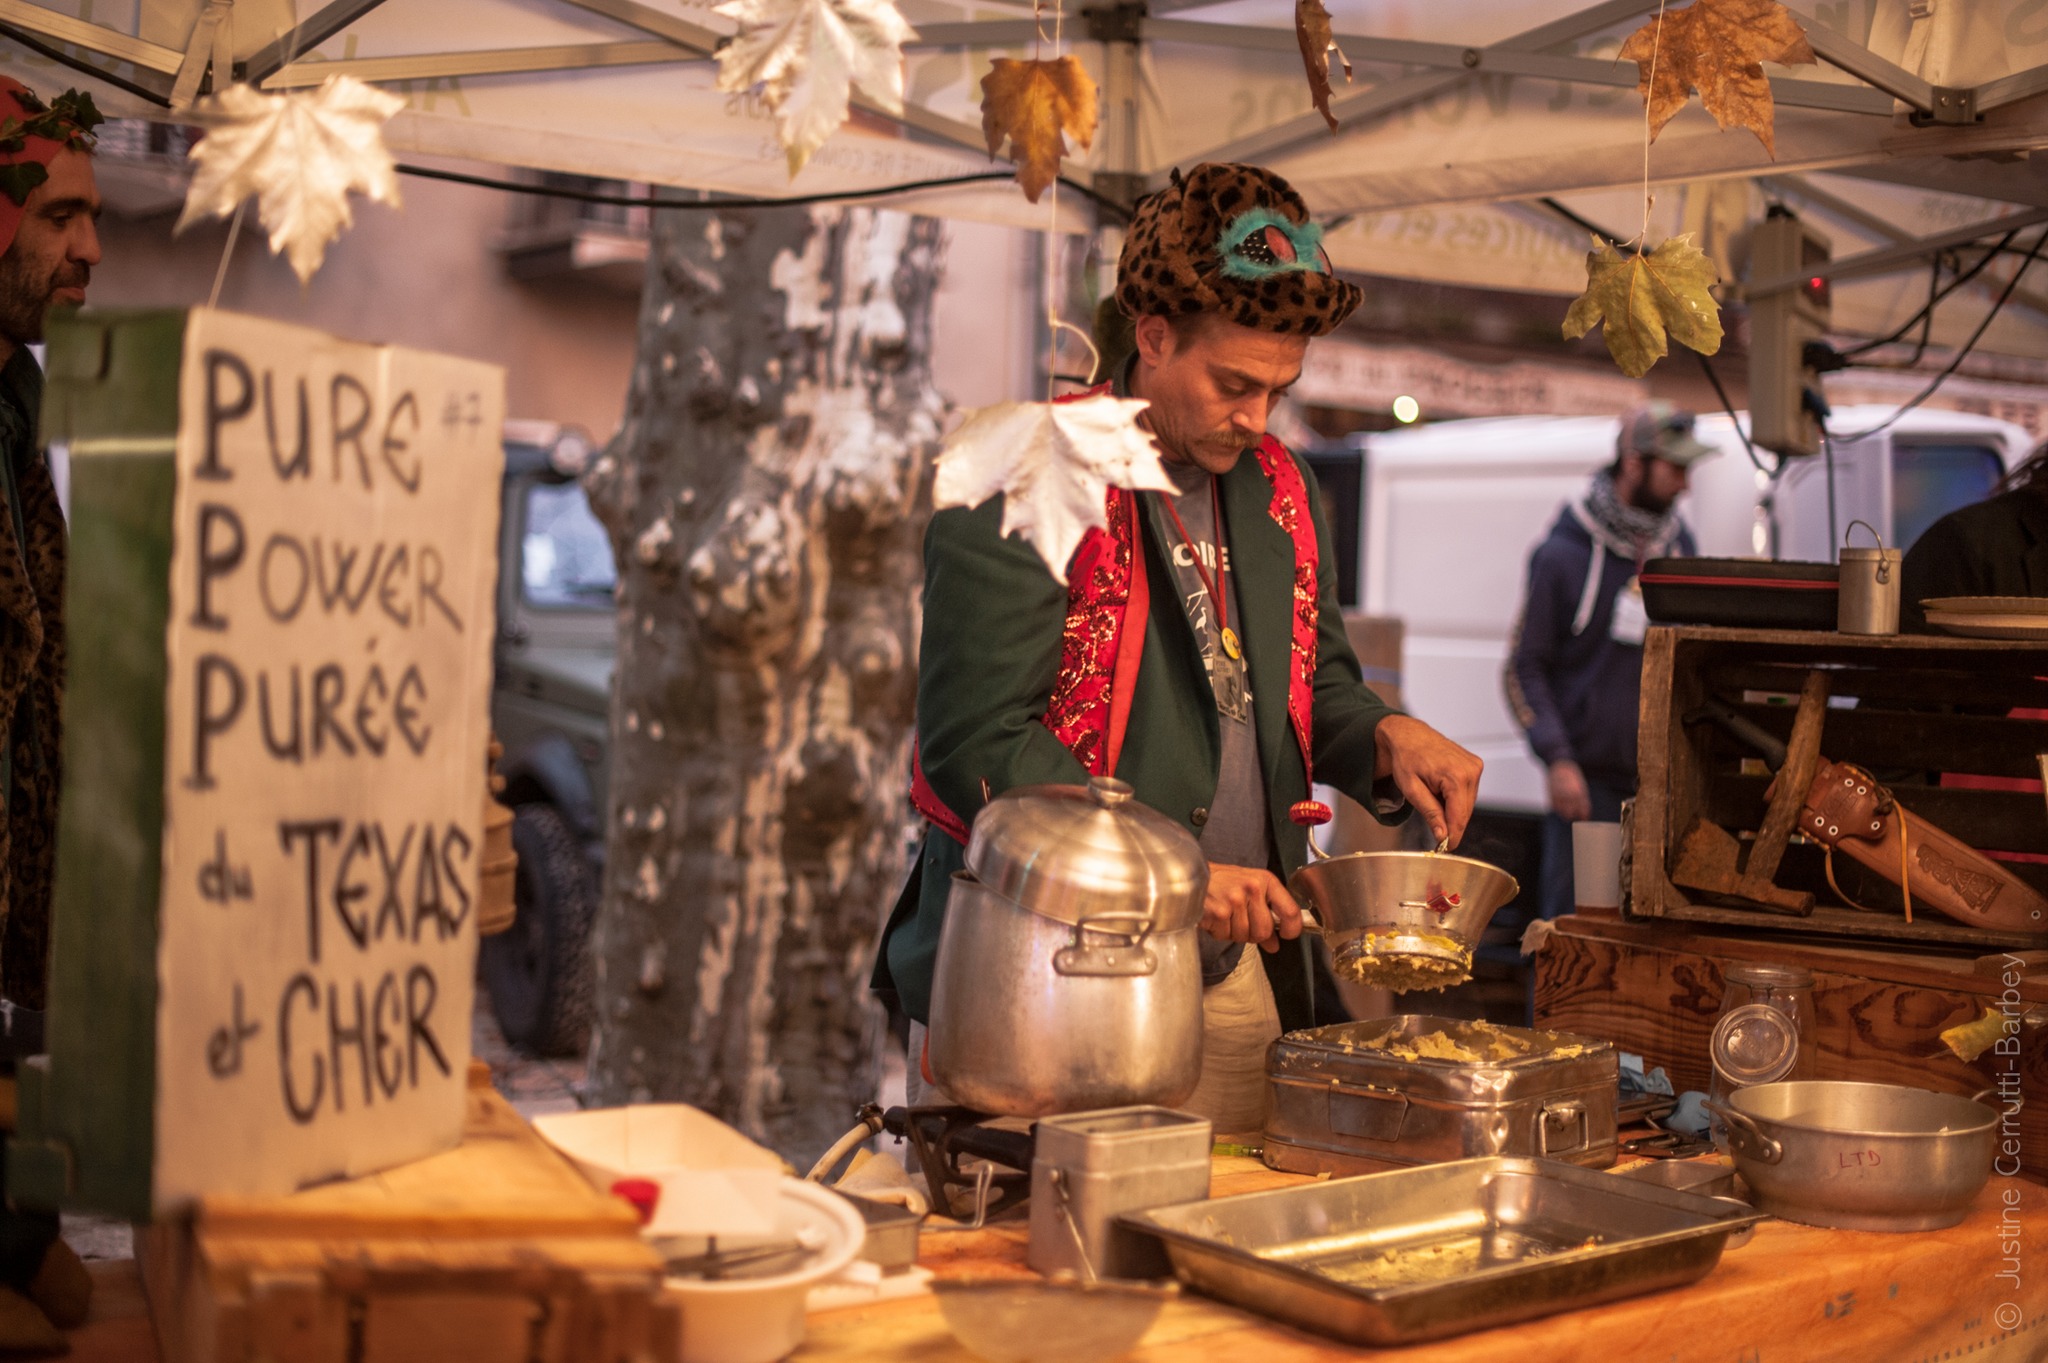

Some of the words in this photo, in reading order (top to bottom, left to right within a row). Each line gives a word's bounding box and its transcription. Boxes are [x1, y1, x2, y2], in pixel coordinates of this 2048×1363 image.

[192, 346, 421, 496] PURE
[188, 502, 465, 636] POWER
[1167, 541, 1230, 572] OIRE
[181, 634, 431, 794] PURÉE
[196, 828, 256, 907] du
[277, 816, 474, 966] TEXAS
[204, 983, 261, 1083] et
[276, 961, 453, 1128] CHER
[1839, 1150, 1881, 1168] LTD
